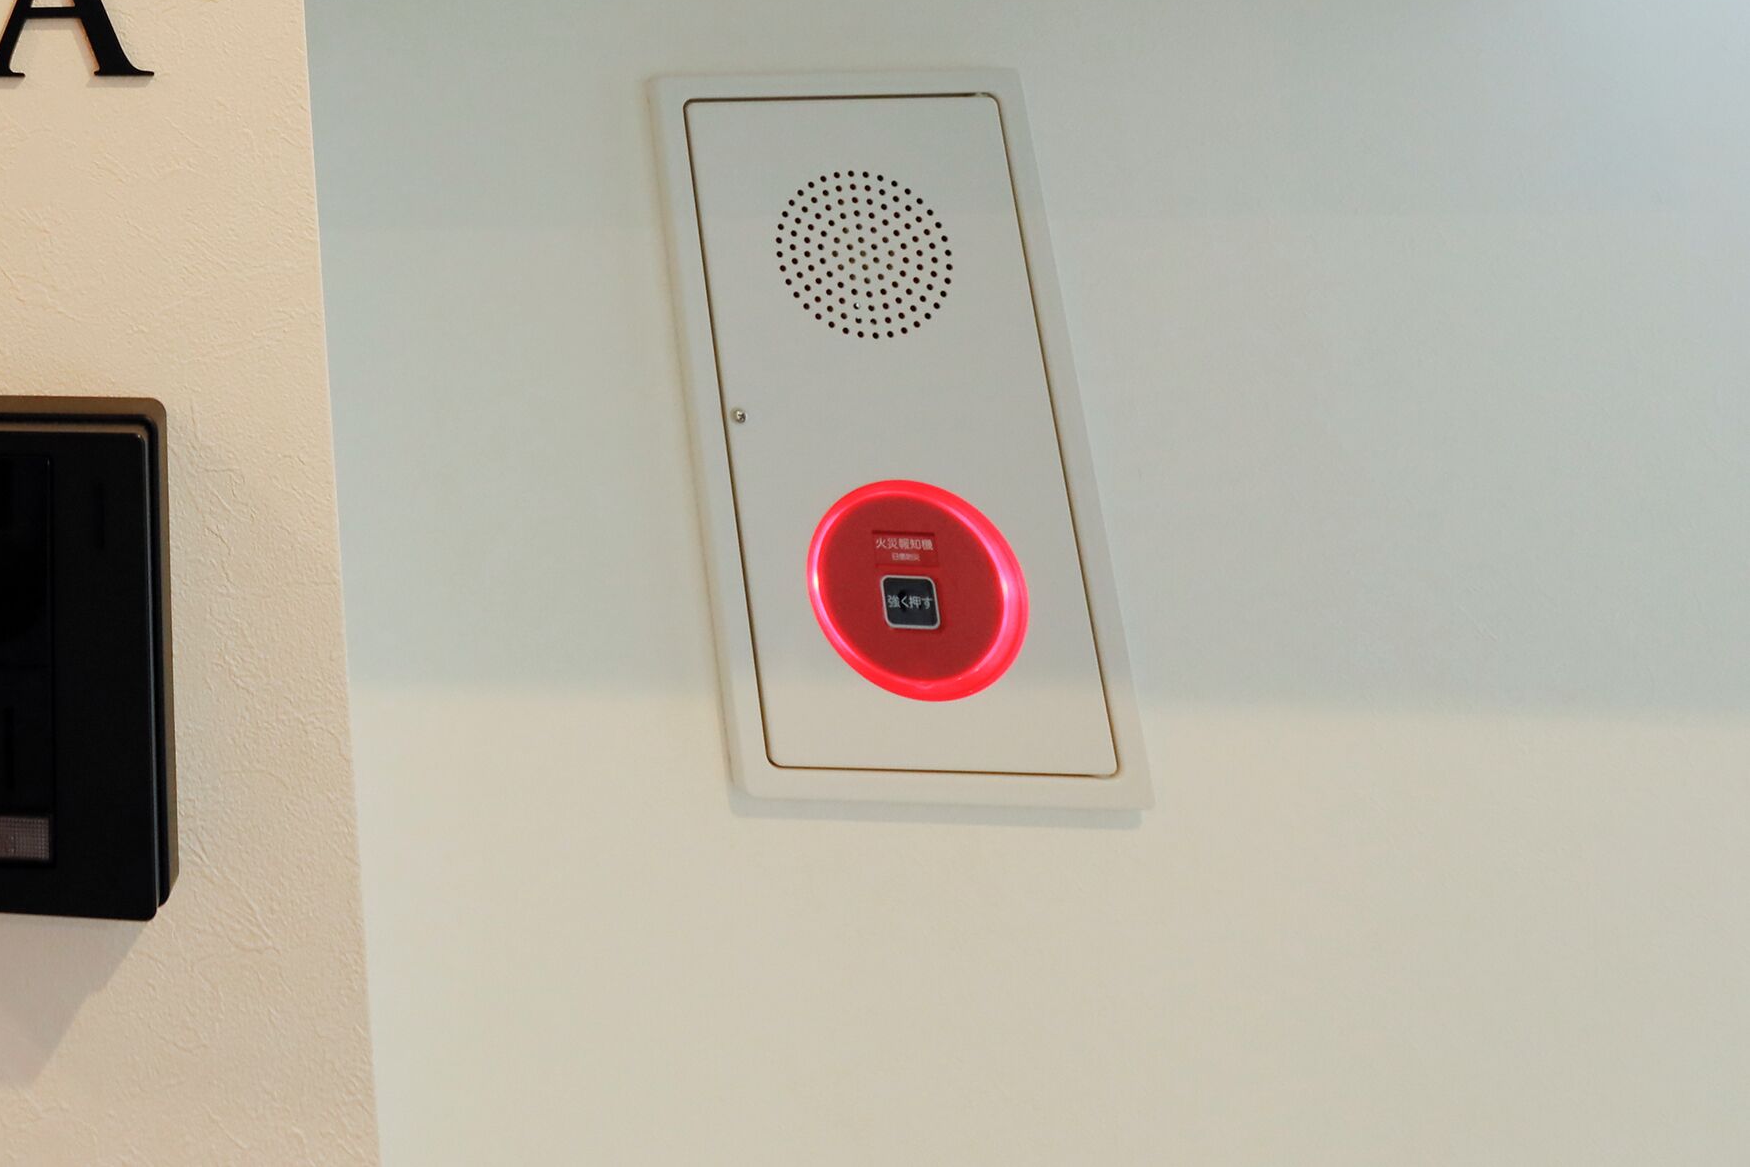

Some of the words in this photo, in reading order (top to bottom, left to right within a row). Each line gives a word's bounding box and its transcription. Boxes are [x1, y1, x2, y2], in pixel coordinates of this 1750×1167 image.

[875, 536, 934, 551] 火災報知機
[886, 594, 934, 610] 強く押す
